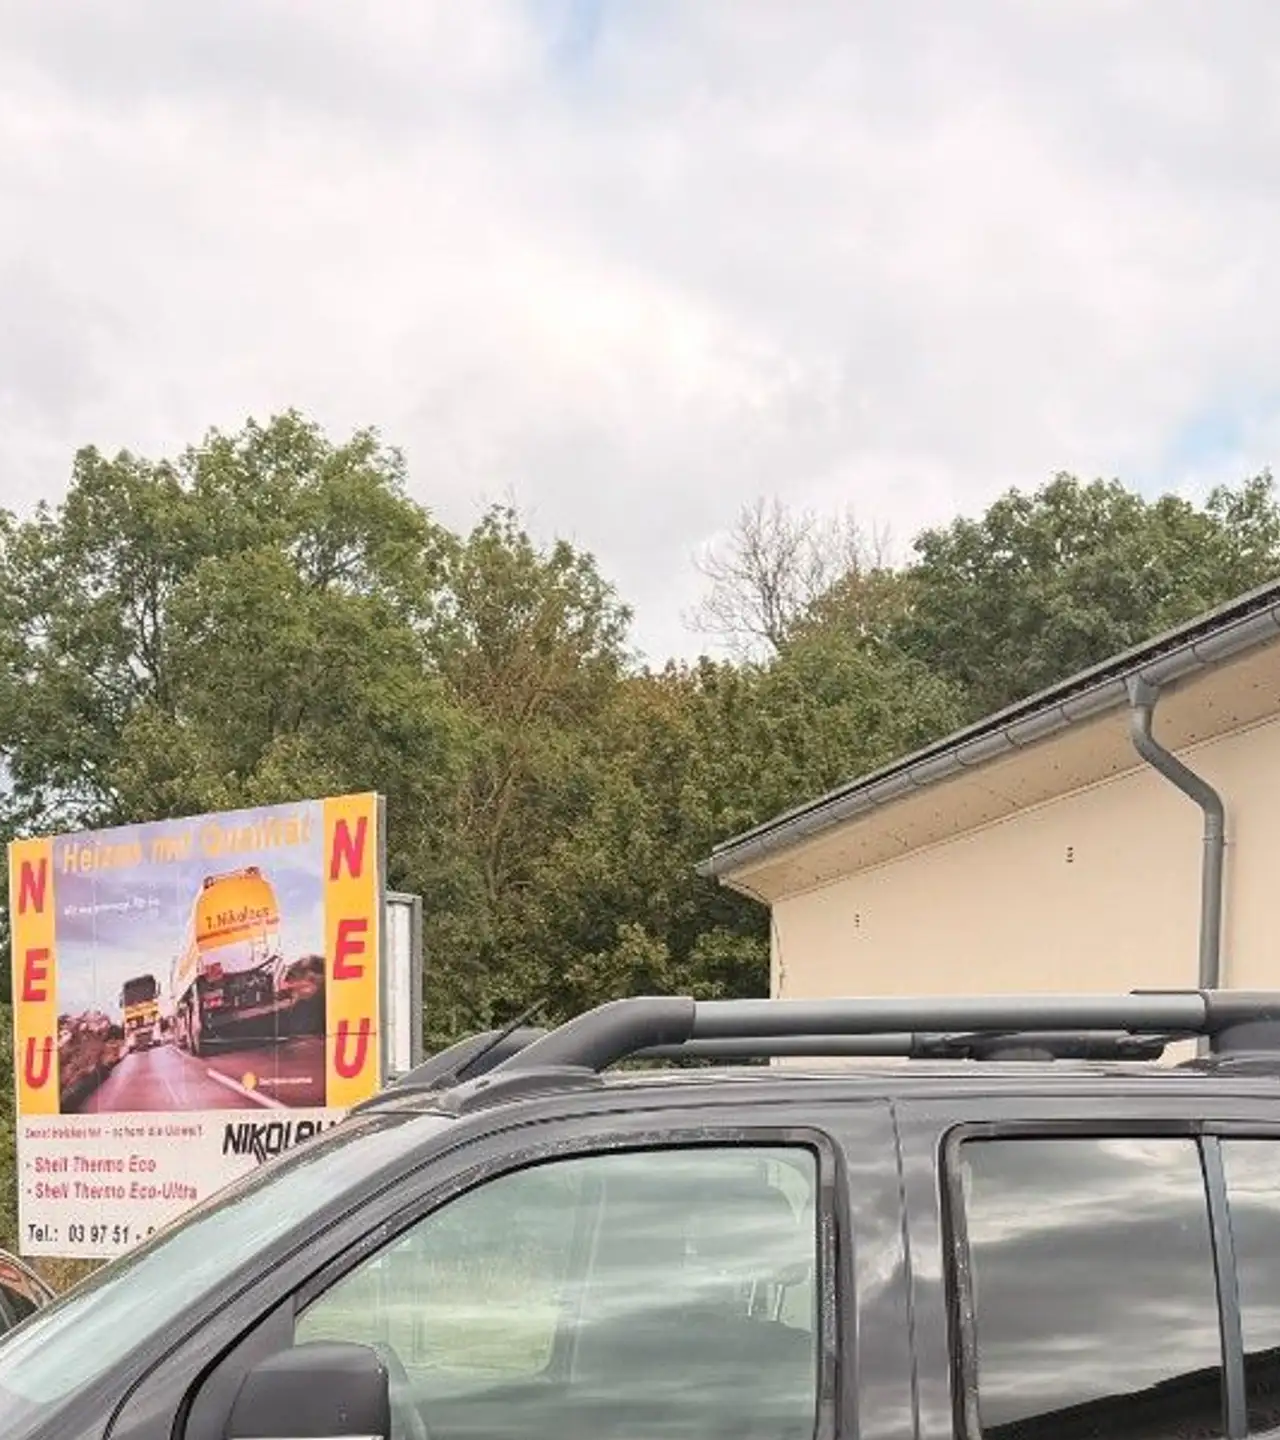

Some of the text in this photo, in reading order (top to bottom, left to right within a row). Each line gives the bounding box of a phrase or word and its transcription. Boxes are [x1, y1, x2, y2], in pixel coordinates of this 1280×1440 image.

[330, 816, 370, 1078] NEU
[18, 857, 53, 1089] NEU
[73, 1155, 125, 1173] Thermo
[128, 1154, 157, 1173] Eco
[74, 1181, 125, 1199] Thermo
[27, 1224, 59, 1242] Tel.:
[68, 1223, 85, 1243] 03
[90, 1224, 107, 1243] 97
[111, 1224, 129, 1243] 51
